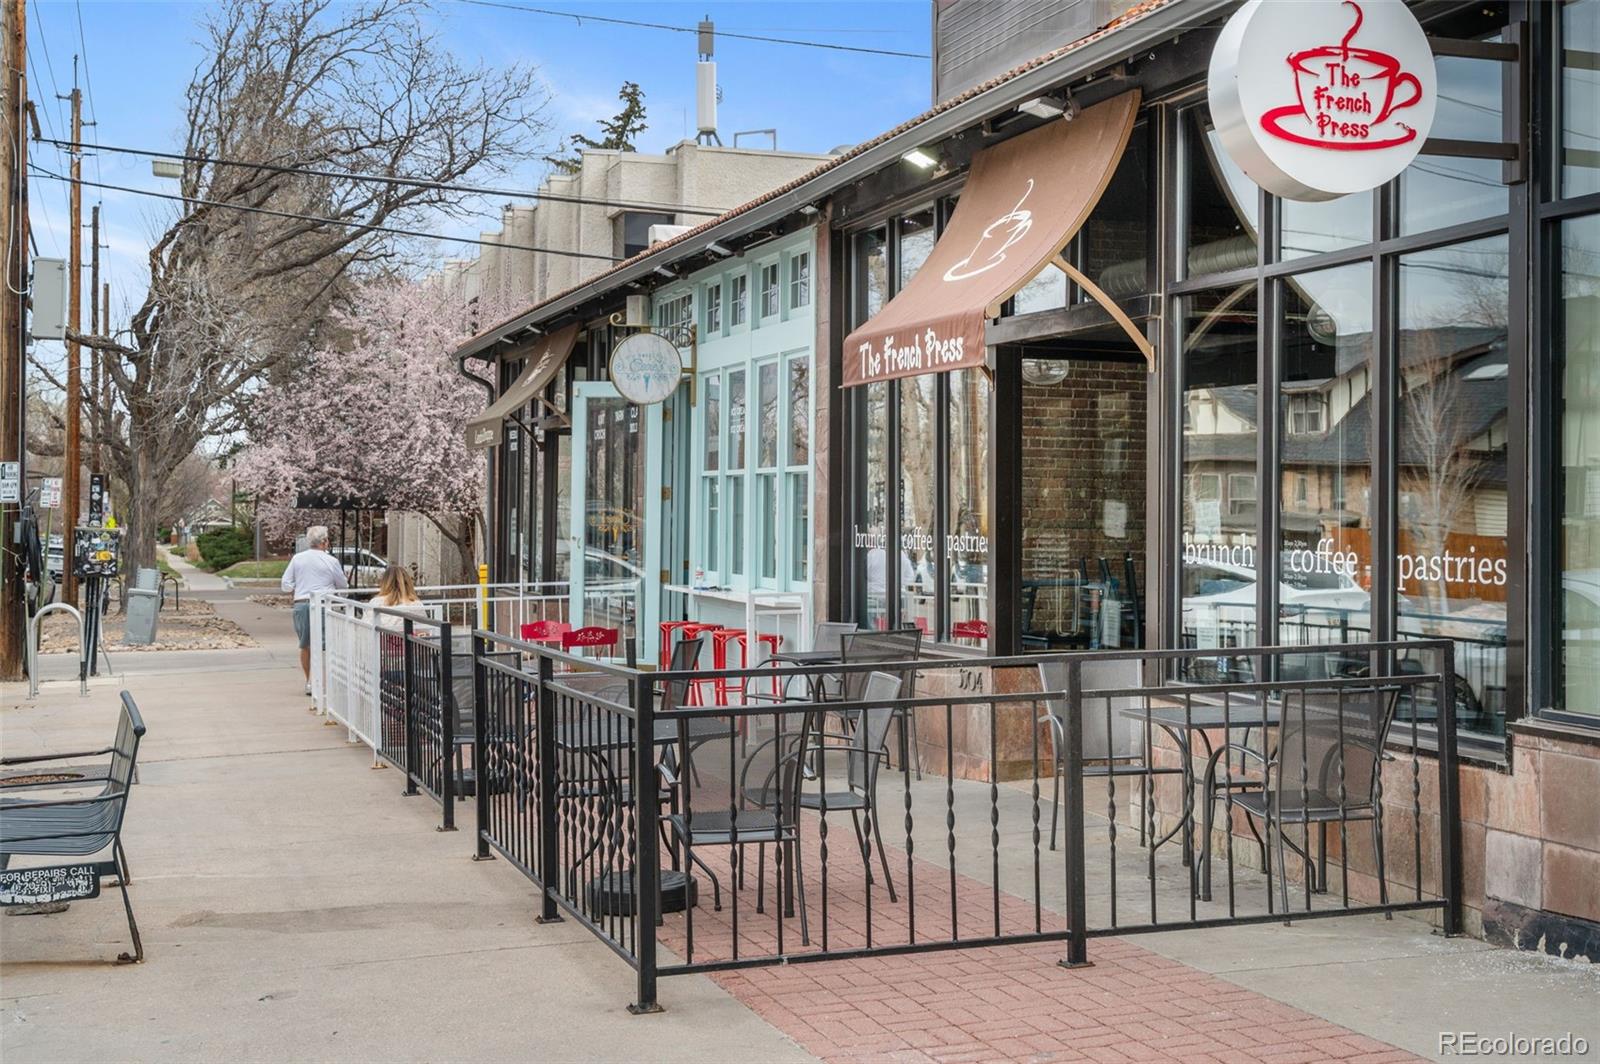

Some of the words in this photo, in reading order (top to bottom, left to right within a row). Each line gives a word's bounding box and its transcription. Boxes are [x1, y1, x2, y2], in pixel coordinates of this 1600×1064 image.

[1326, 63, 1360, 87] The
[1314, 86, 1371, 113] French
[1316, 111, 1369, 138] Press
[859, 340, 881, 379] The
[883, 333, 922, 375] French
[924, 327, 964, 368] Press
[854, 525, 887, 549] brunch
[901, 527, 933, 551] coffee
[1184, 531, 1255, 568] brunch
[1290, 538, 1359, 576] coffee
[1397, 545, 1507, 591] pastries
[0, 872, 21, 882] FOR
[24, 868, 67, 879] REPAIRS
[69, 866, 95, 877] CALL
